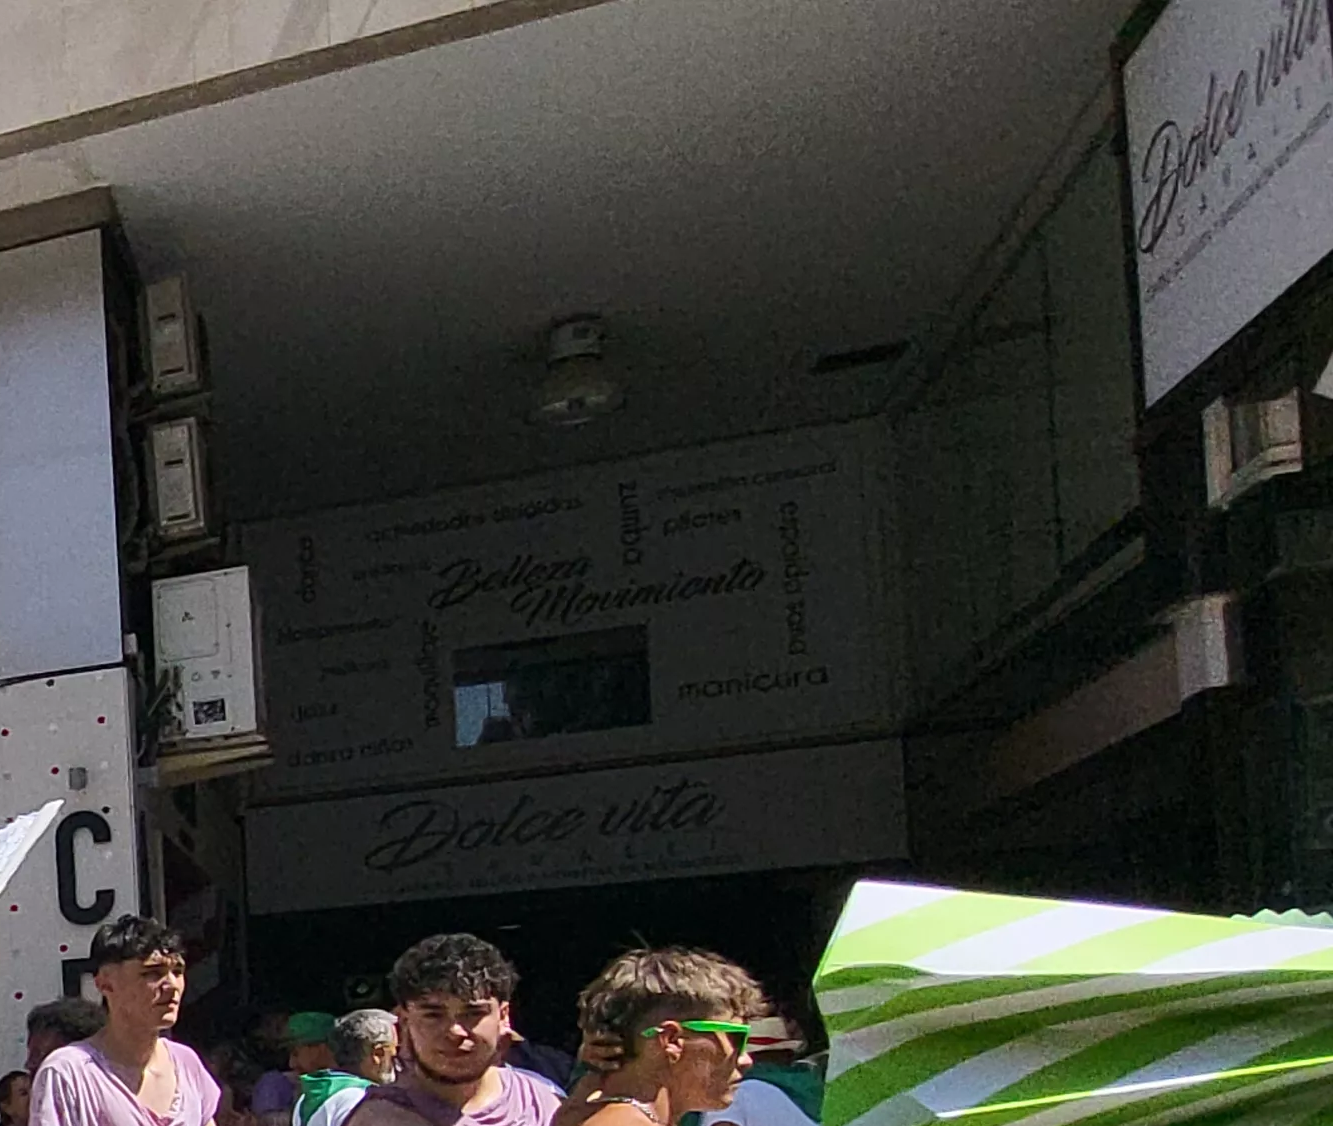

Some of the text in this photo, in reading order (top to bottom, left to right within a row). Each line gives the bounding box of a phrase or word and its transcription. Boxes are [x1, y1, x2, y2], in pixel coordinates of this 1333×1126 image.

[1137, 70, 1250, 254] Dolce
[617, 480, 649, 567] zumba
[661, 506, 744, 538] pilates
[427, 553, 595, 611] Belleza
[509, 556, 768, 628] Movimiento
[675, 664, 831, 702] manicura
[364, 778, 727, 872] Dolce vita
